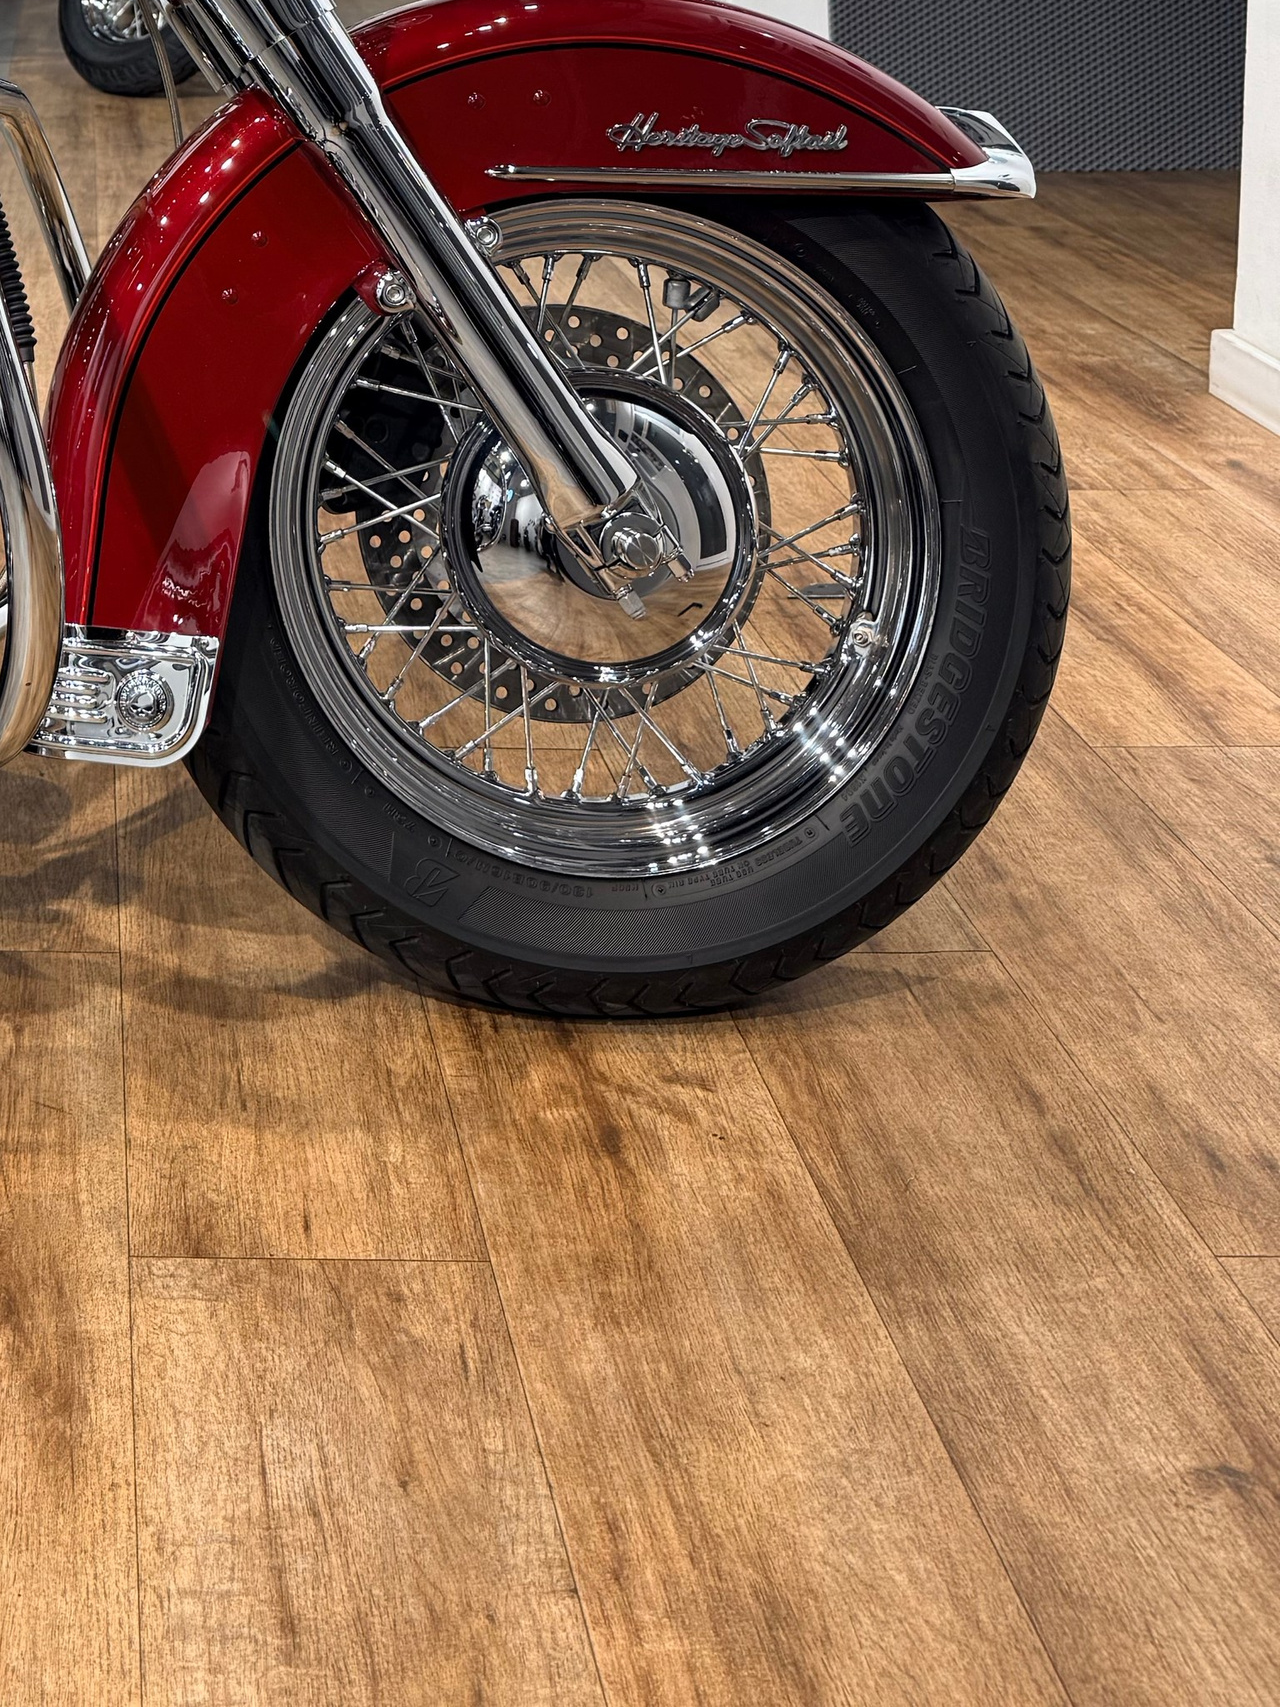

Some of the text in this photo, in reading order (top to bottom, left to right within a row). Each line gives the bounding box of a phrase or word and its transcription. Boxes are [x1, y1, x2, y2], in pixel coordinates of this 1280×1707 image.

[606, 111, 848, 157] Heritage Softail
[838, 524, 991, 848] BRIDGESTONE
